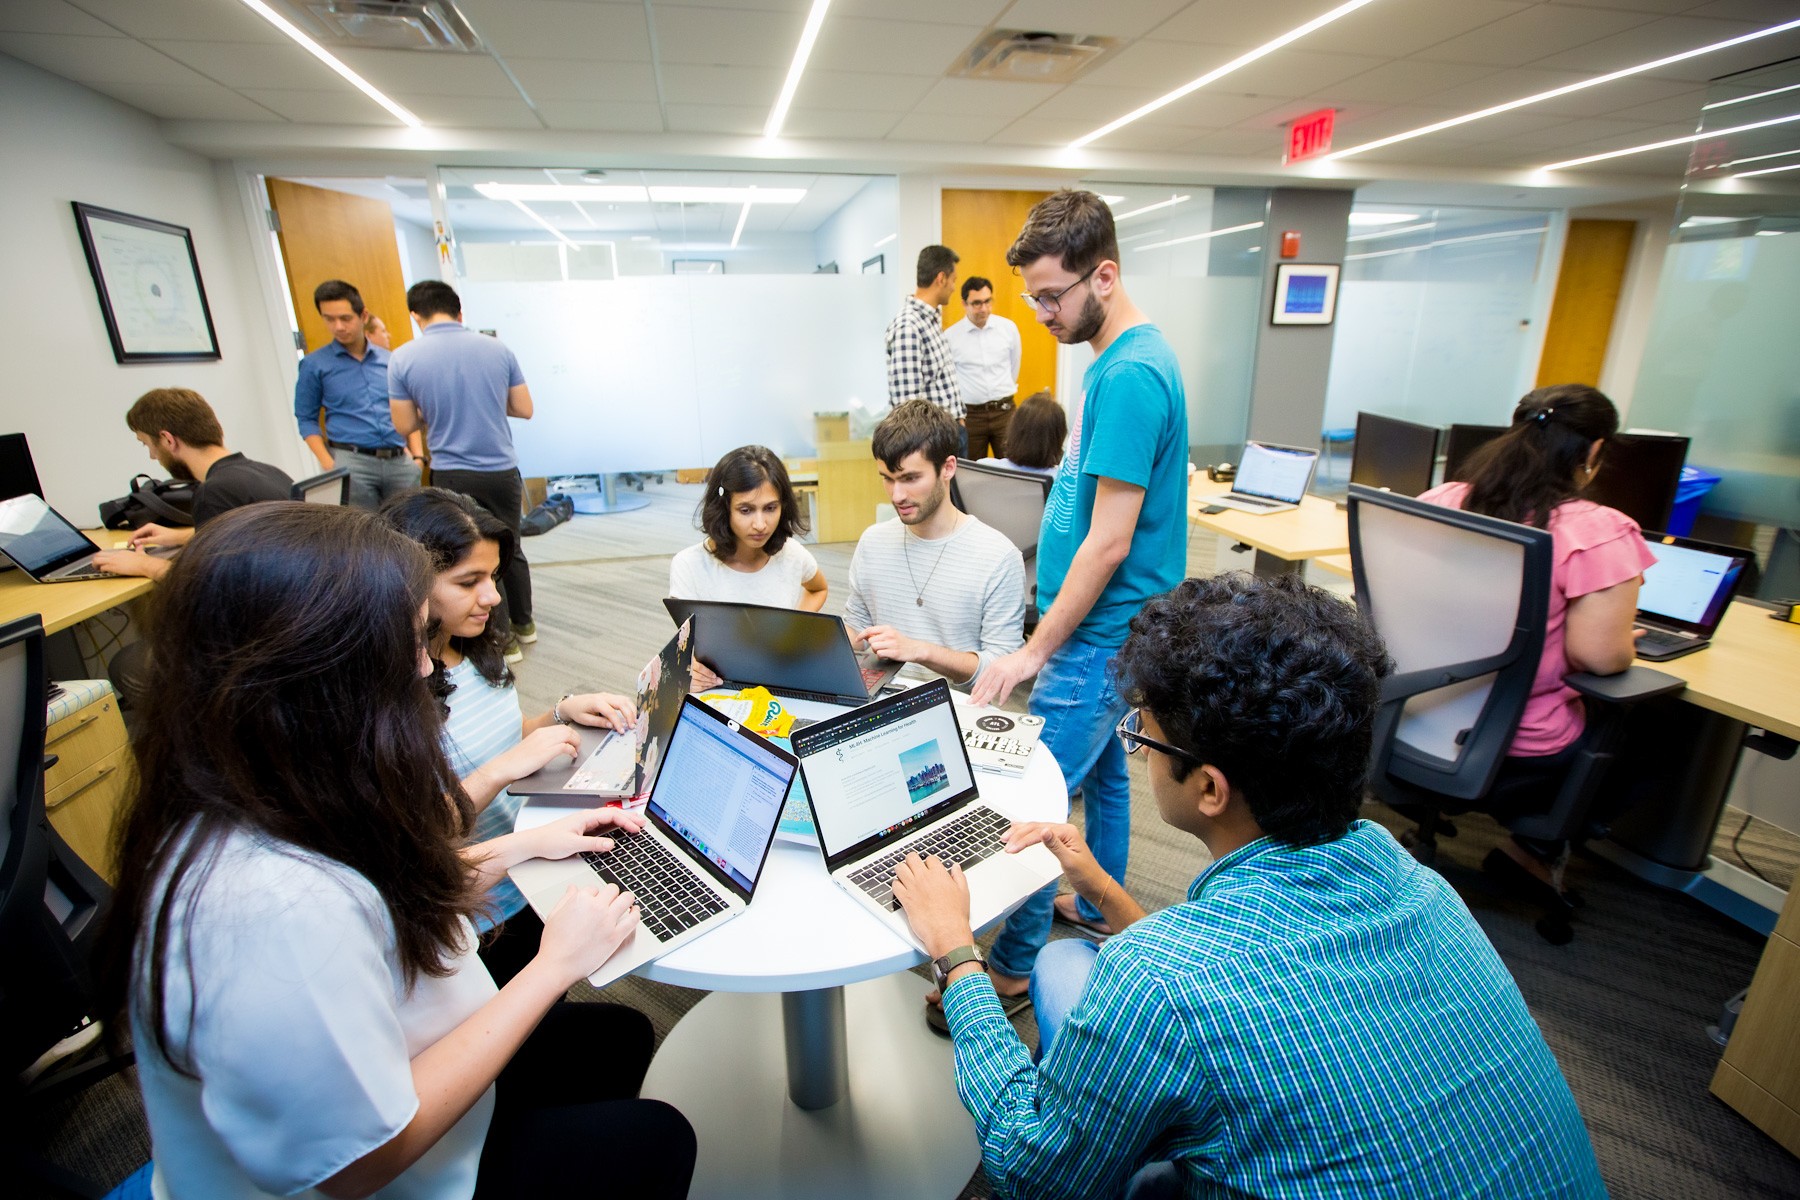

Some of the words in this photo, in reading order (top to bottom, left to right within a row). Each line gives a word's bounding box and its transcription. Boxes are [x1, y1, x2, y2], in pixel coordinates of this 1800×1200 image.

[1292, 118, 1327, 159] EXIT
[863, 734, 880, 744] Machine
[880, 727, 898, 737] Learning
[903, 719, 917, 727] Health
[964, 737, 1032, 757] ATTERS
